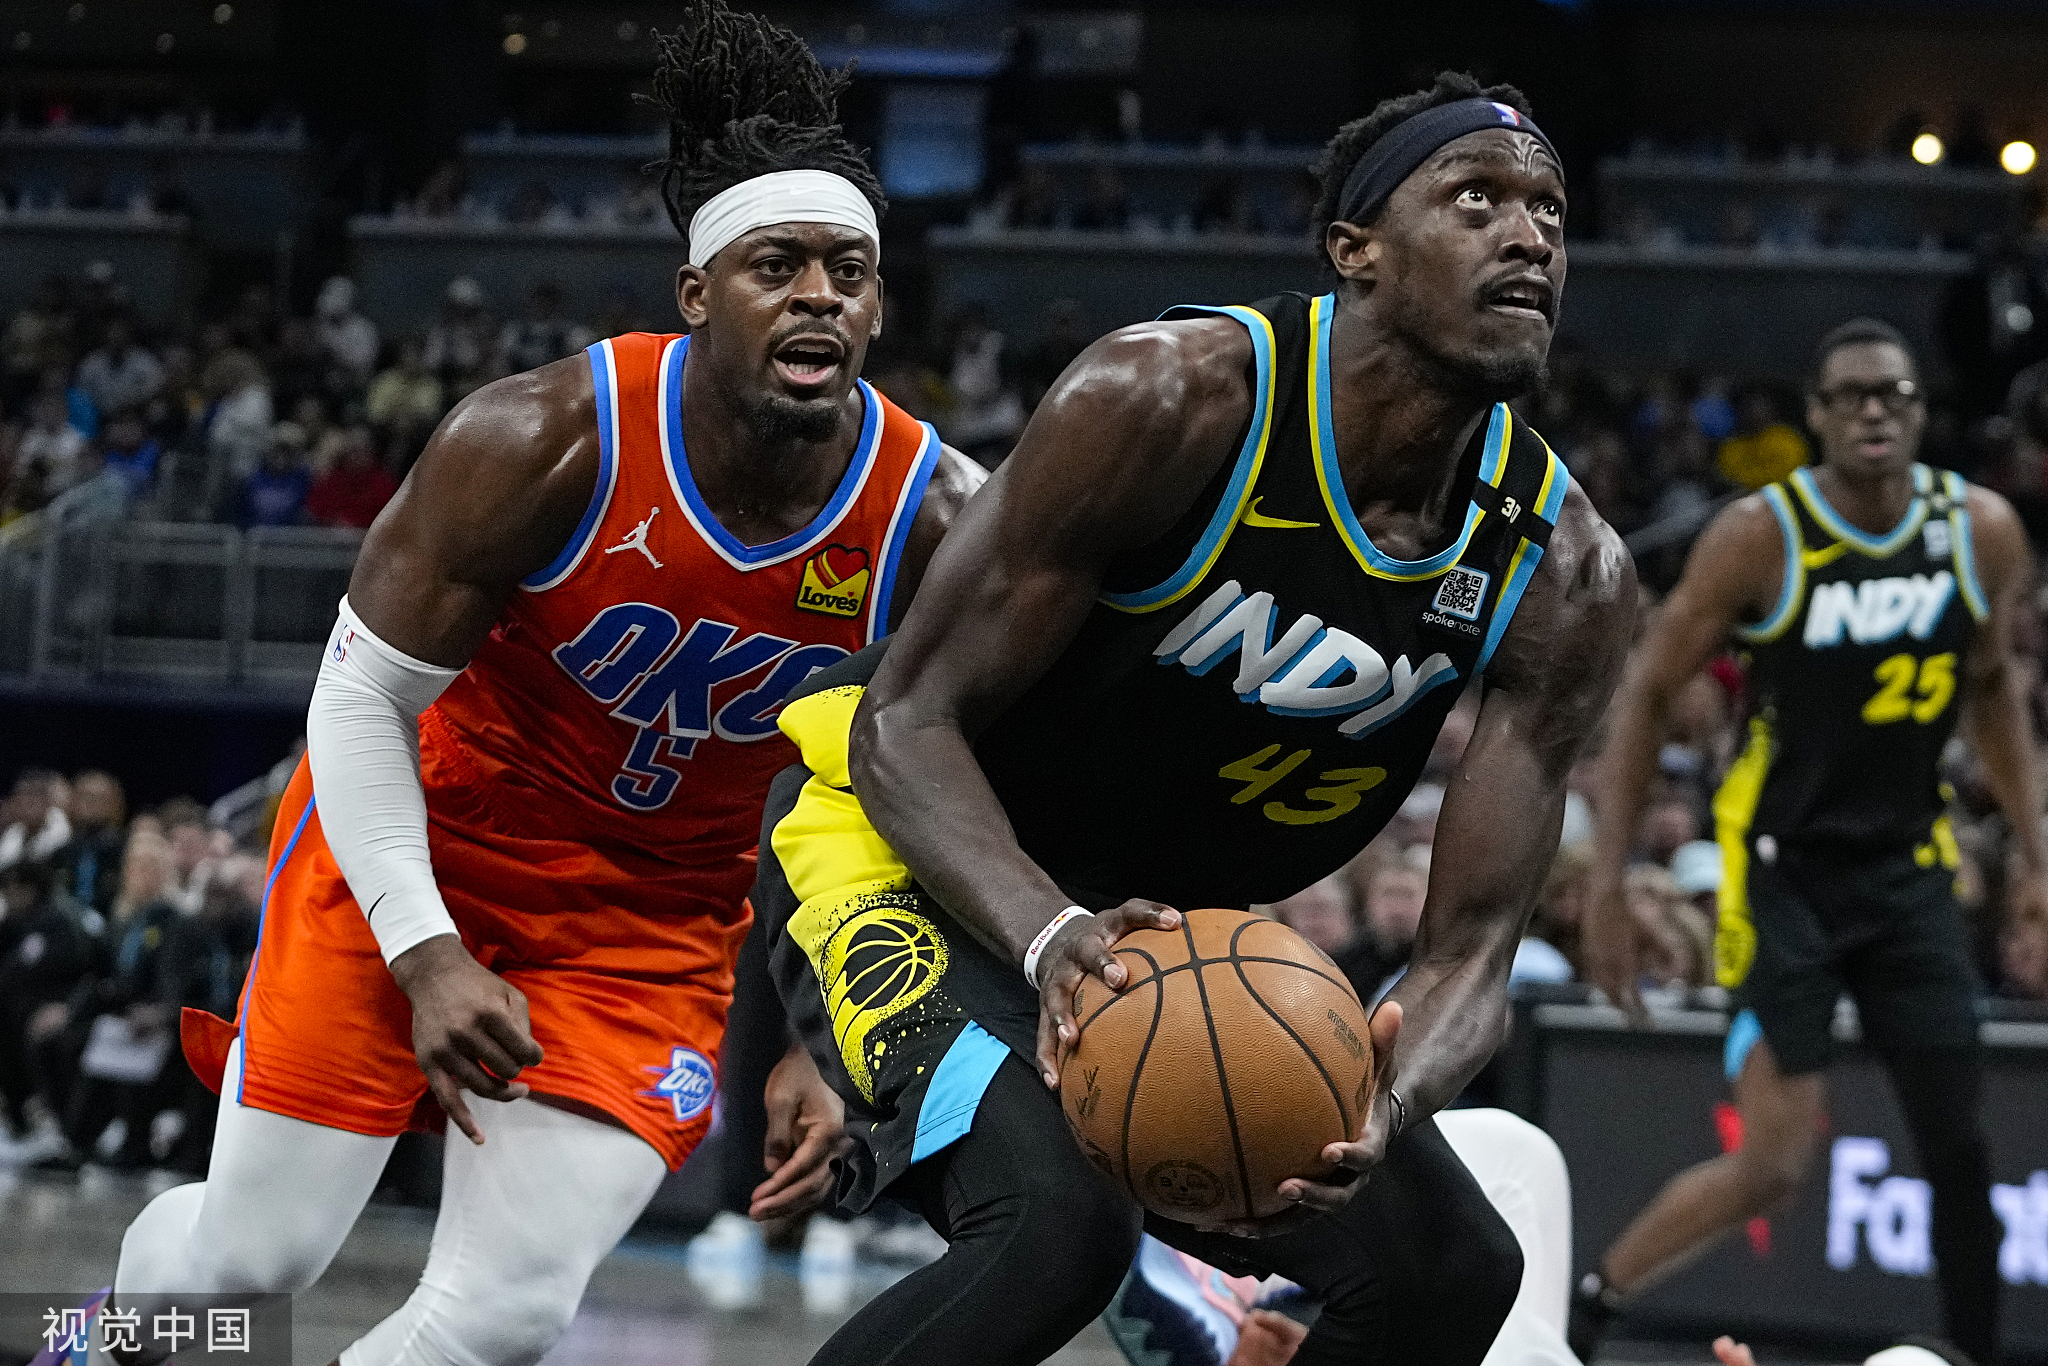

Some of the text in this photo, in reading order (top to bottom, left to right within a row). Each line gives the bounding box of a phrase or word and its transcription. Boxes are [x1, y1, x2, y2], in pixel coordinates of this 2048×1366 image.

[1422, 611, 1481, 636] spokenote
[1803, 570, 1957, 648] INDY
[1152, 580, 1458, 740] INDY
[1861, 652, 1957, 725] 25
[611, 727, 698, 811] 5
[1218, 743, 1388, 825] 43
[1030, 939, 1043, 956] Red
